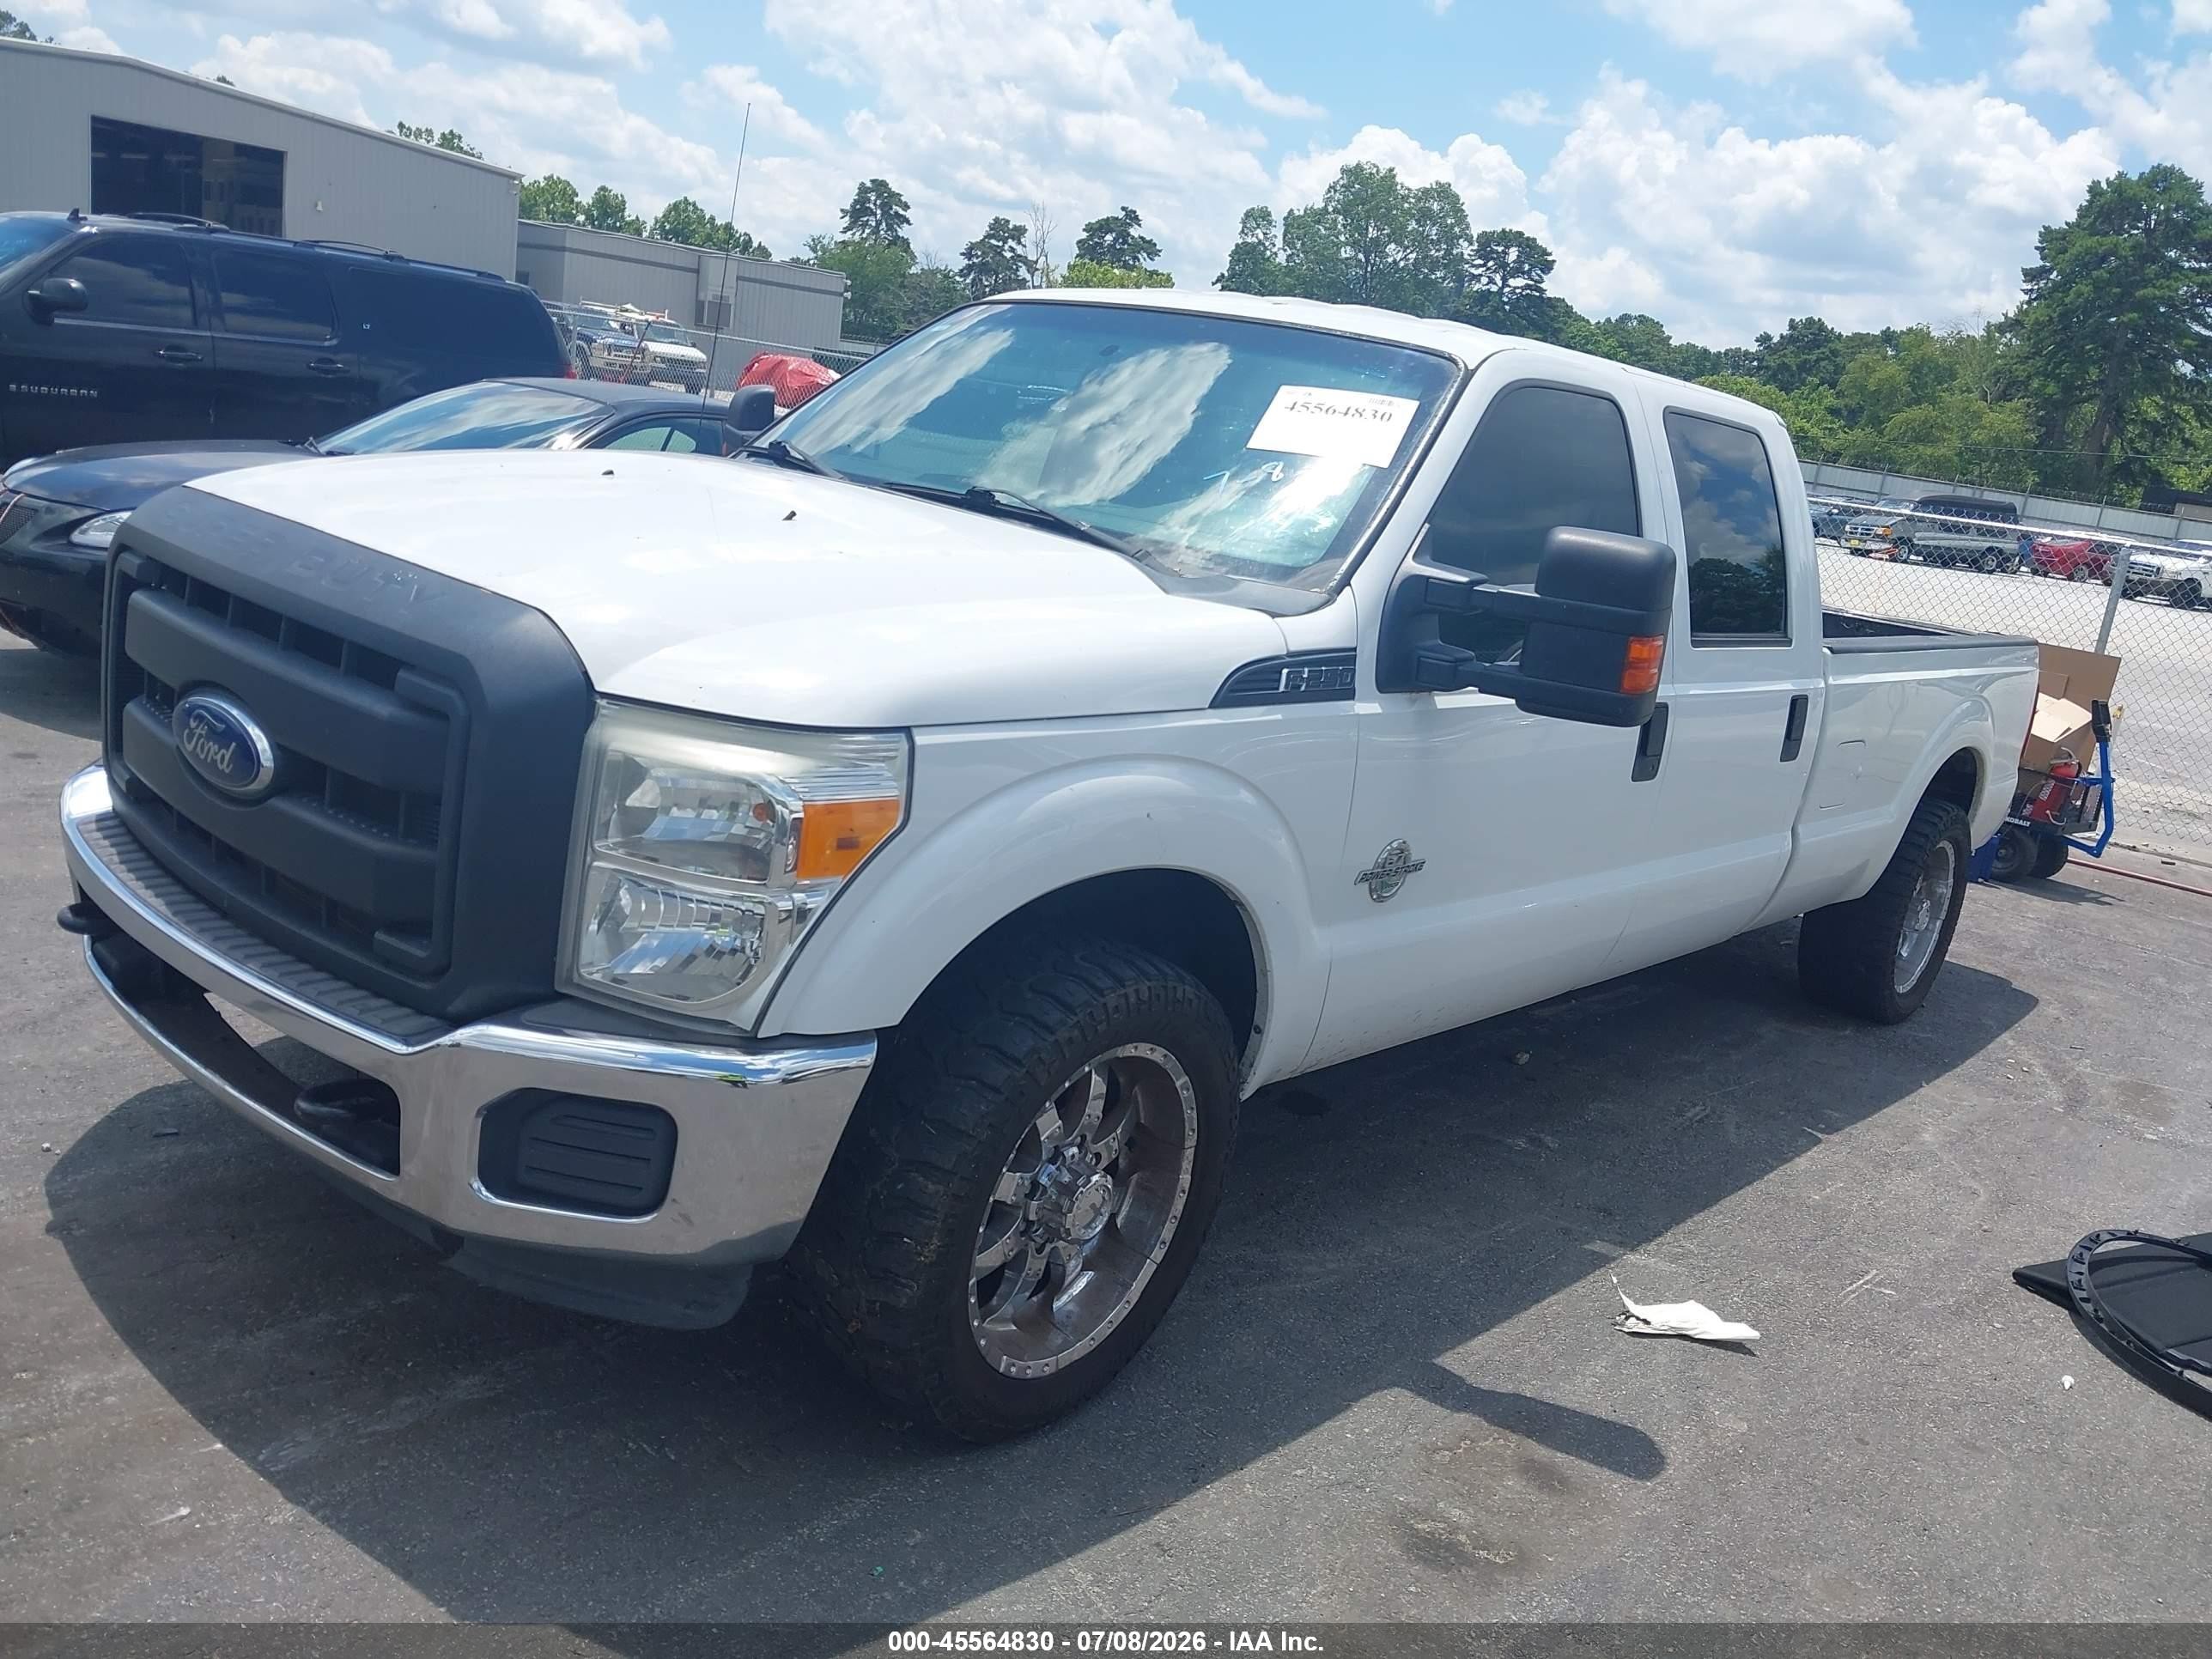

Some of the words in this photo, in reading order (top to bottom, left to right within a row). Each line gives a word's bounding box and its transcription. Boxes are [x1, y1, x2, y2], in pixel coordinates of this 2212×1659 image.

[20, 385, 98, 397] SUBURBAN
[1284, 400, 1394, 422] 45564830
[183, 709, 237, 774] Ford
